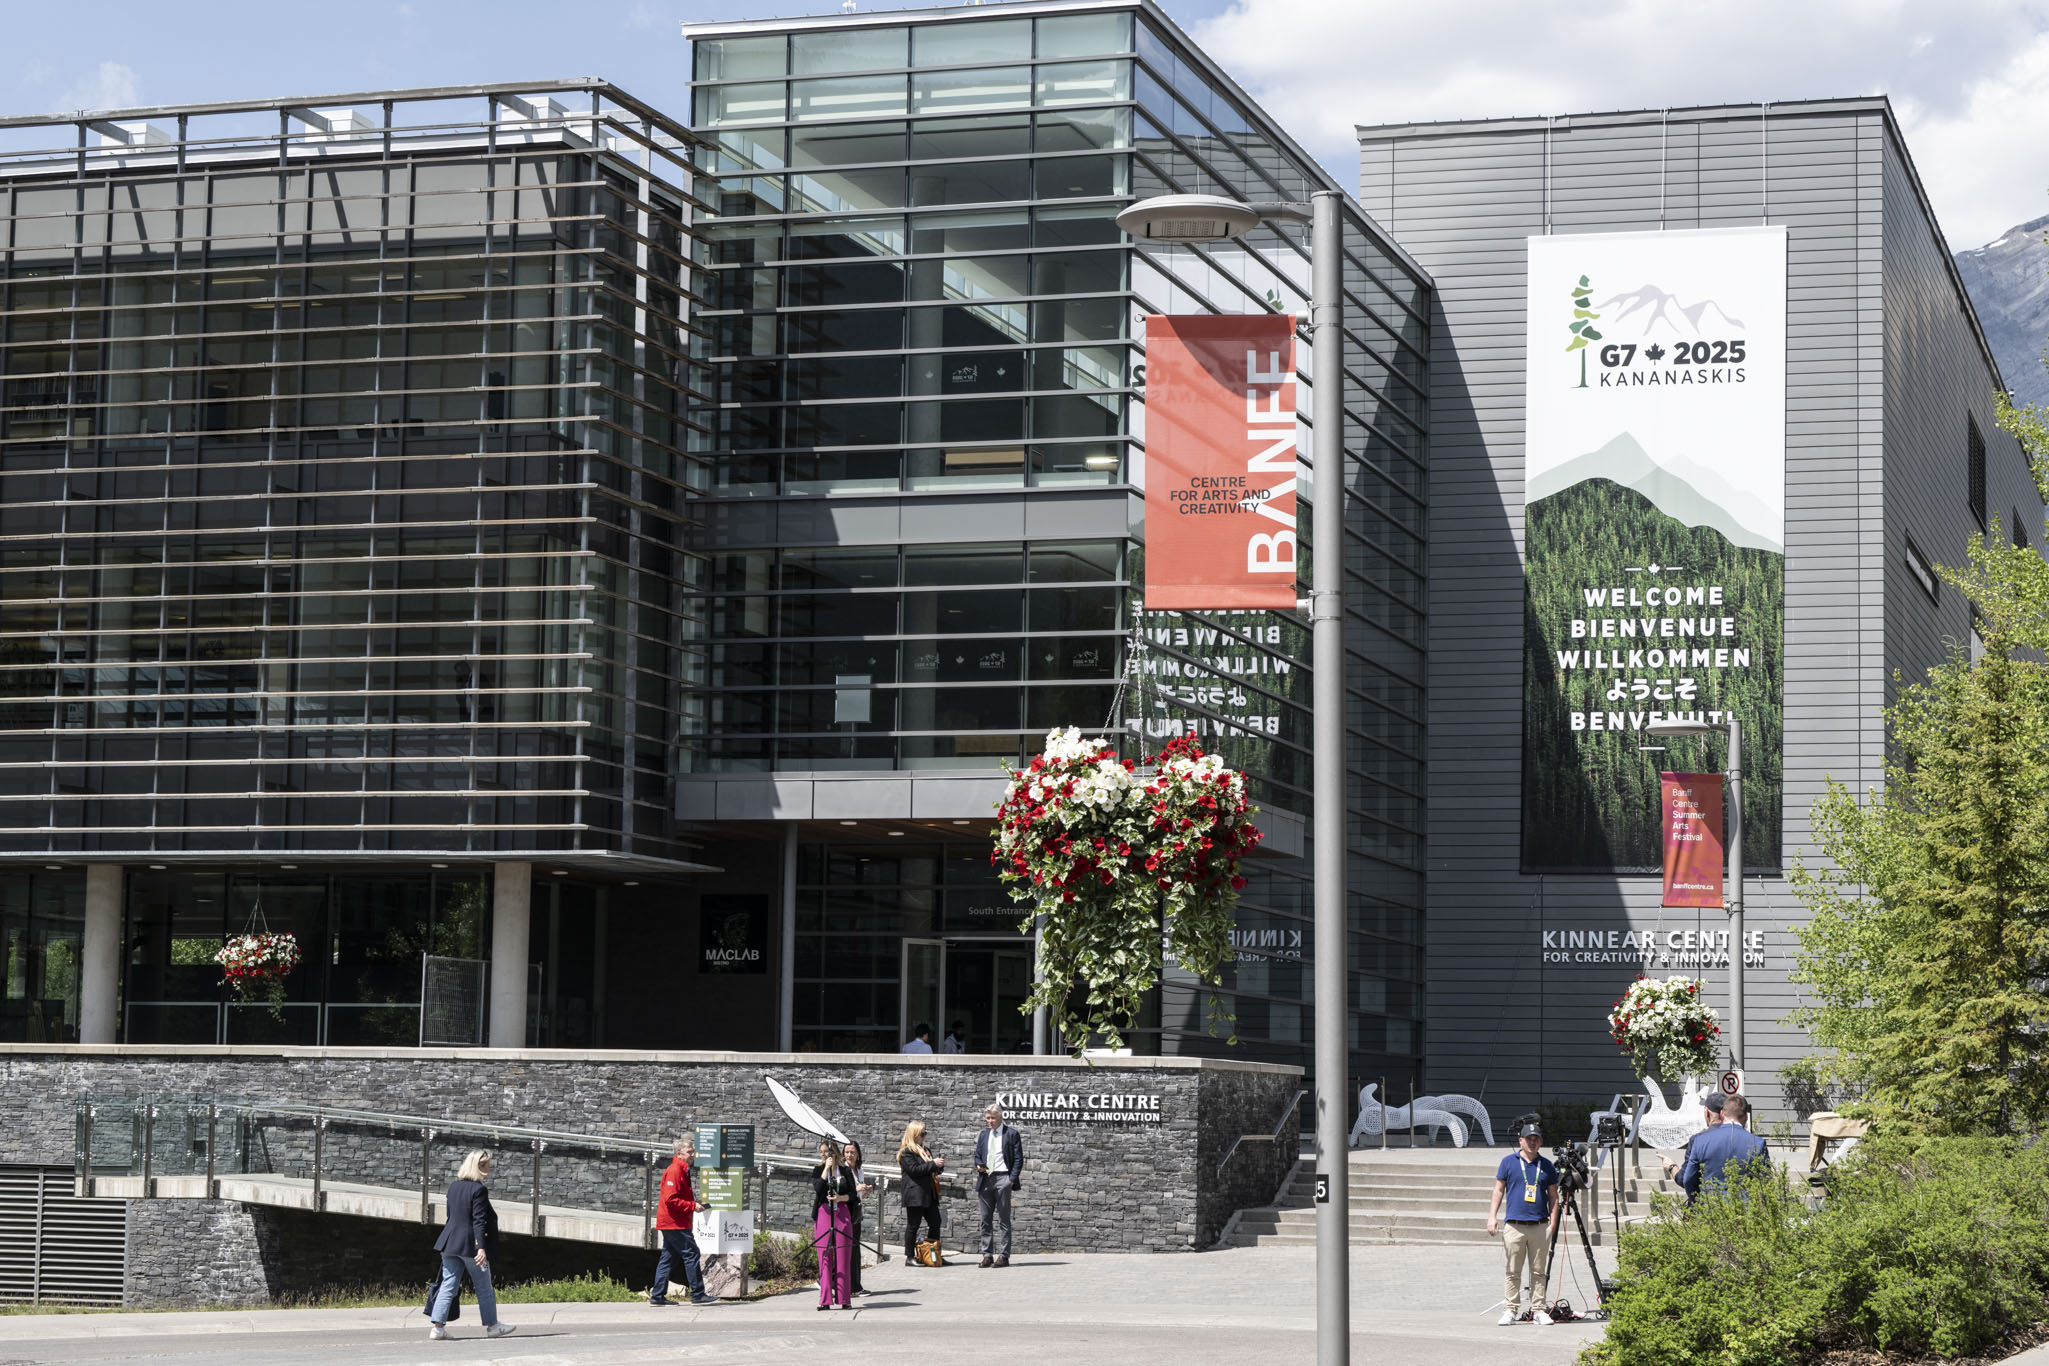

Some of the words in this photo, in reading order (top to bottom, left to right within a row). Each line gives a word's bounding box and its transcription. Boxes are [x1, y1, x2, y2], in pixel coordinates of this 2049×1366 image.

[1600, 344, 1637, 367] G7
[1673, 340, 1746, 365] 2025
[1600, 368, 1746, 387] KANANASKIS
[1246, 350, 1297, 573] BANFF
[1190, 476, 1246, 488] CENTRE
[1170, 490, 1198, 501] FOR
[1202, 489, 1239, 501] ARTS
[1241, 489, 1271, 500] AND
[1179, 503, 1260, 515] CREATIVITY
[1584, 586, 1723, 607] WELCOME
[1571, 617, 1735, 638] BIENVENUE
[1556, 648, 1750, 669] WILLKOMMEN
[1606, 678, 1697, 700] ようこそ
[1672, 788, 1692, 797] Banff
[1672, 800, 1699, 808] Centre
[1672, 811, 1706, 819] Summer
[1672, 822, 1689, 830] Arts
[1672, 833, 1703, 841] Festival
[968, 906, 994, 915] South
[996, 906, 1034, 915] Entrance
[1543, 930, 1656, 949] KINNEAR
[705, 948, 760, 961] MACLAB
[1543, 952, 1570, 963] FOR
[1575, 952, 1655, 963] CREATIVITY
[1659, 952, 1670, 963] &
[1675, 952, 1764, 963] INNOVAON
[995, 1093, 1080, 1108] KINNEAR
[1088, 1094, 1160, 1109] CENTRE
[998, 1111, 1016, 1120] OR
[1020, 1111, 1079, 1121] CREATIVITY
[1083, 1112, 1091, 1121] &
[1094, 1112, 1160, 1122] INNOVATION
[1317, 1180, 1327, 1198] 5
